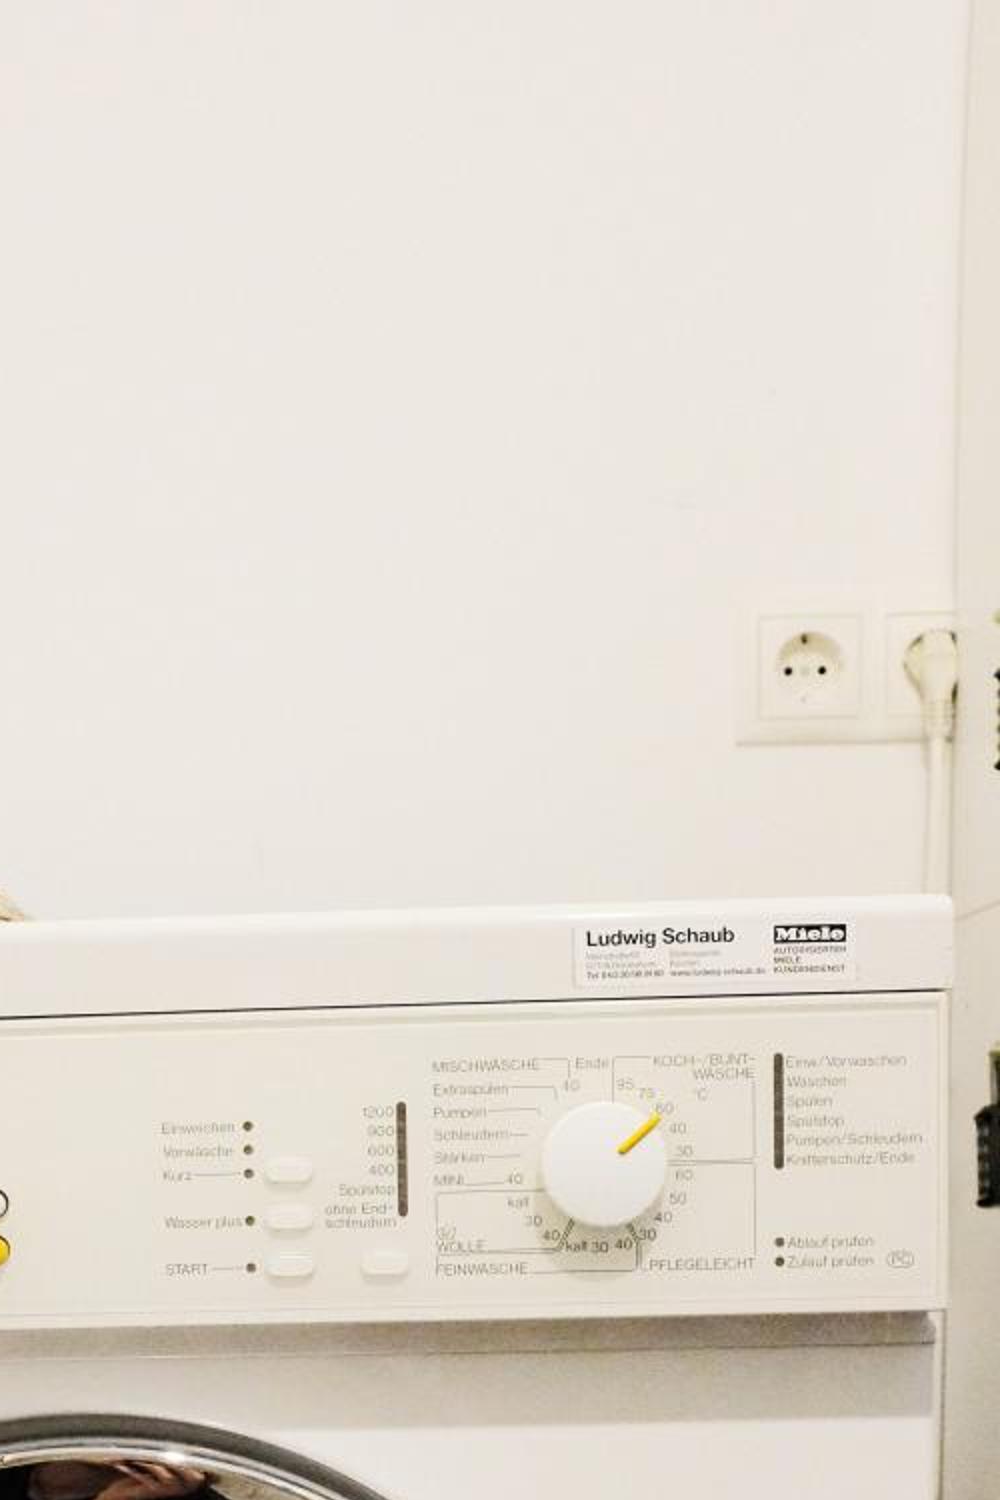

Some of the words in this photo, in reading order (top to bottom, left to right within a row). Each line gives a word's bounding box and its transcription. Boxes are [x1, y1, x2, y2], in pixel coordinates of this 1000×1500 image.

[586, 929, 656, 948] Ludwig
[663, 927, 735, 944] Schaub
[775, 926, 845, 941] Miele
[575, 1057, 609, 1069] Ende
[616, 1077, 634, 1090] 95
[363, 1105, 394, 1118] 1200
[433, 1107, 487, 1120] Pumpen
[655, 1102, 674, 1114] 60
[161, 1121, 235, 1135] Einweichen
[367, 1125, 394, 1137] 900
[669, 1122, 687, 1134] 40
[434, 1128, 511, 1141] Schleudern
[367, 1145, 394, 1157] 600
[163, 1171, 192, 1181] Kurz
[368, 1164, 394, 1176] 400
[675, 1169, 693, 1181] 60
[507, 1173, 523, 1185] 40
[669, 1192, 687, 1205] 50
[325, 1203, 356, 1216] ohne
[164, 1216, 214, 1229] Wasser
[215, 1214, 243, 1230] plus
[525, 1215, 543, 1227] 30
[654, 1211, 673, 1223] 40
[542, 1229, 561, 1241] 40
[639, 1227, 657, 1241] 30
[436, 1239, 487, 1252] WOLLE
[565, 1240, 588, 1252] kalt
[590, 1241, 609, 1253] 30
[614, 1238, 634, 1250] 40
[649, 1257, 756, 1271] PFLEGELEICHT
[786, 1255, 828, 1269] Zulauf
[165, 1263, 208, 1276] START
